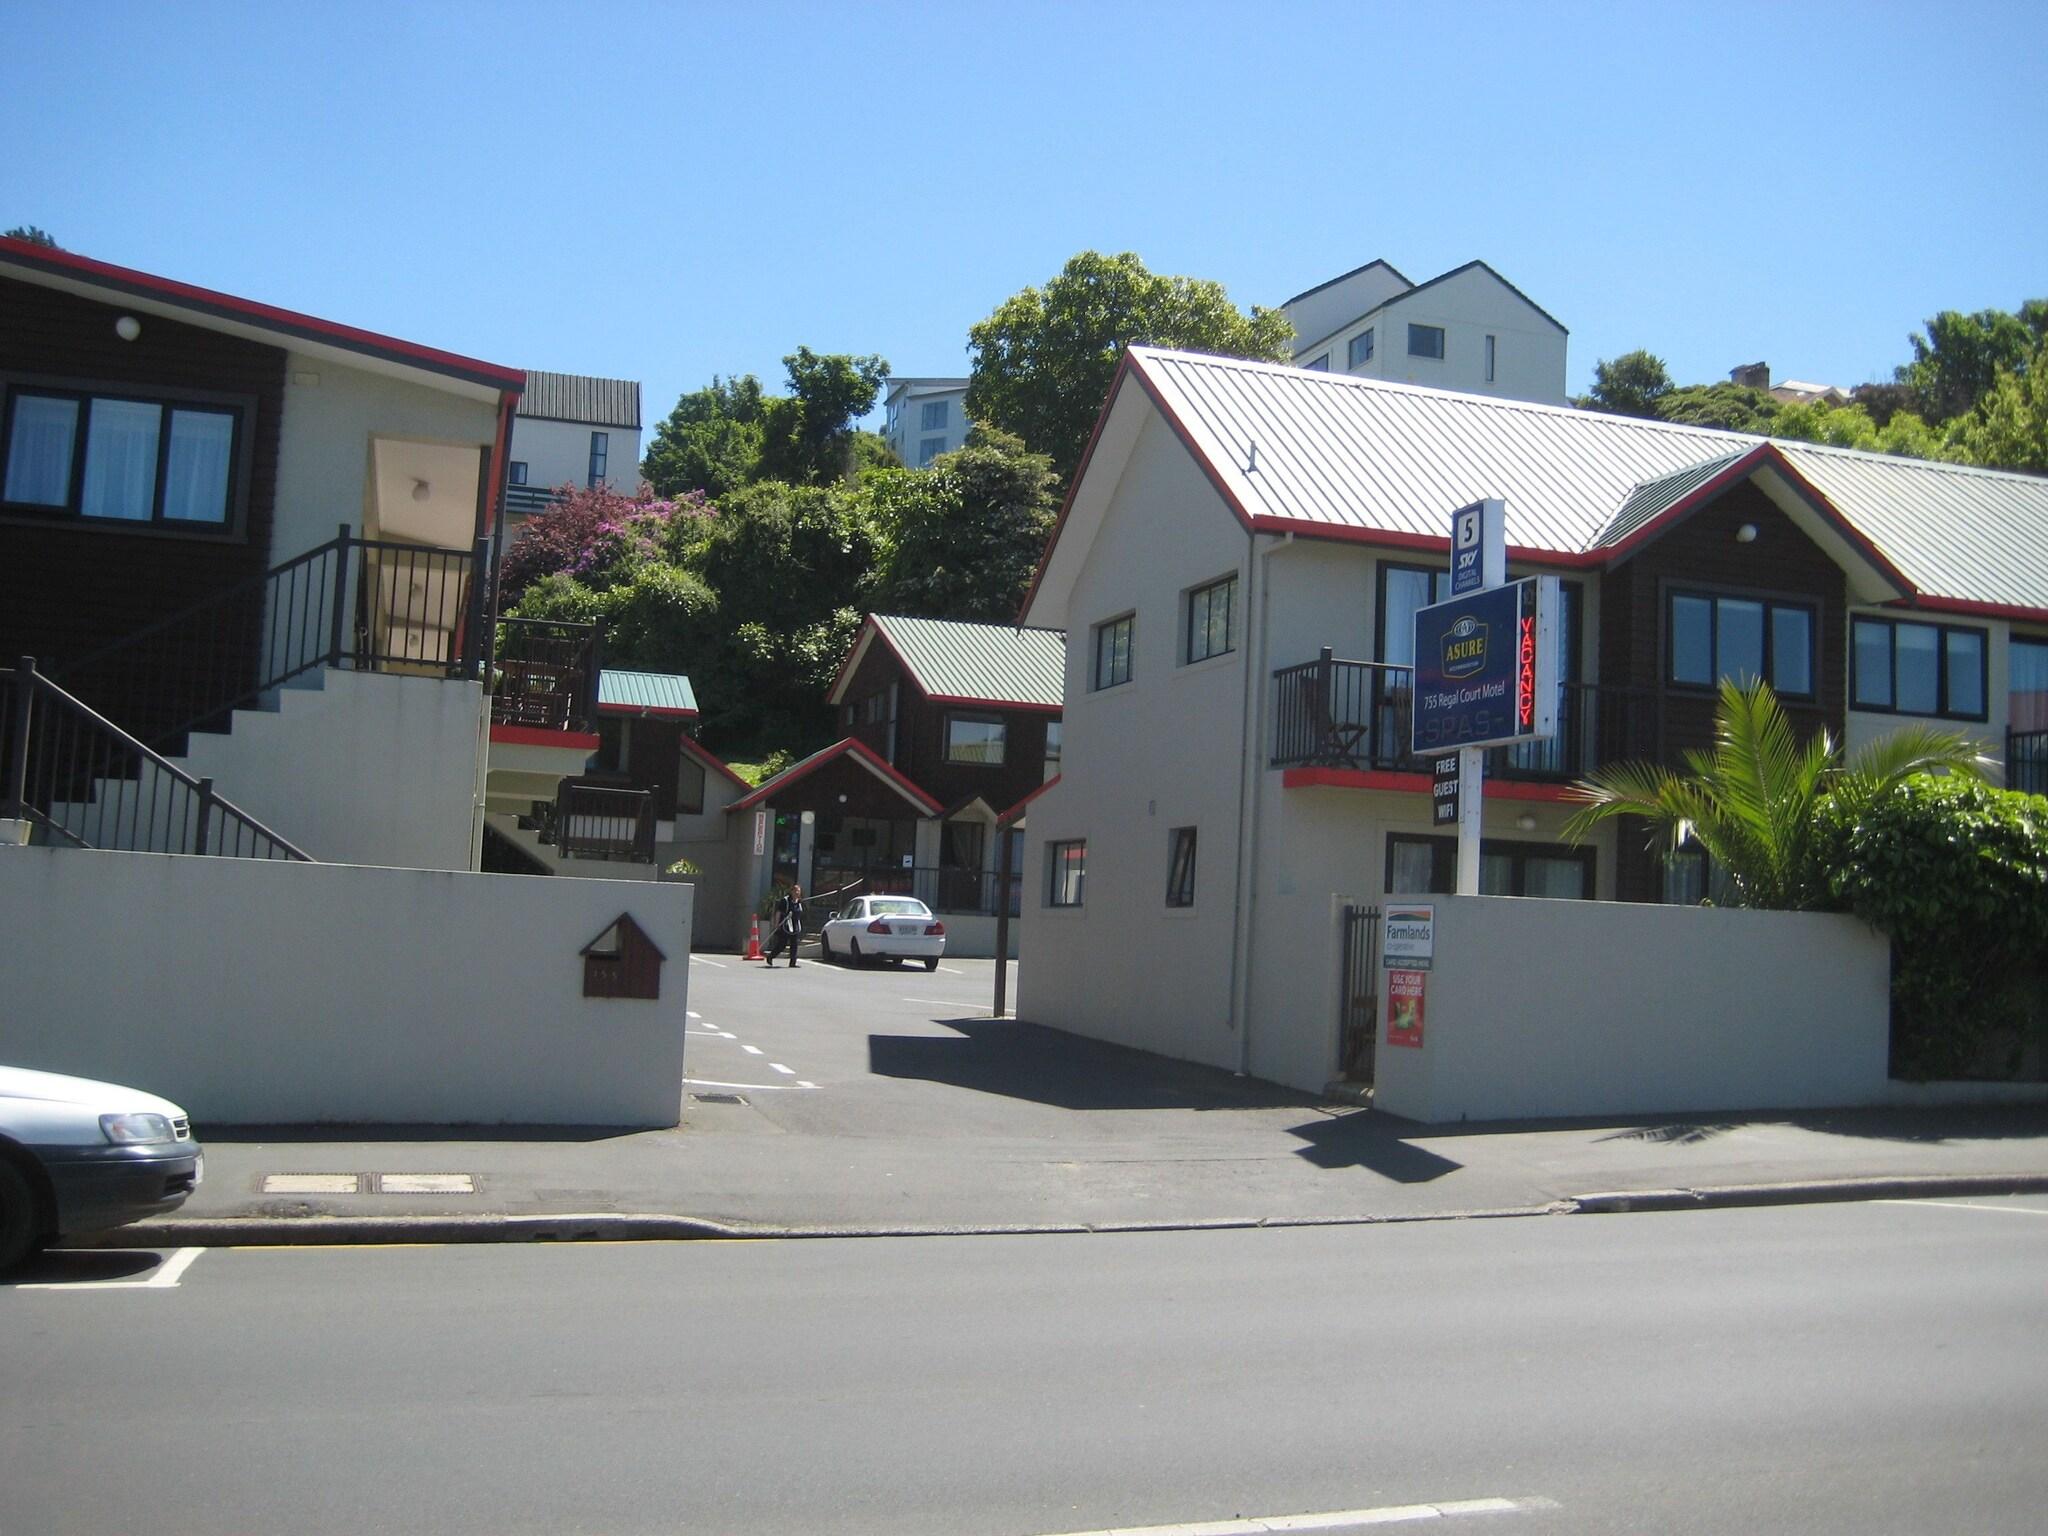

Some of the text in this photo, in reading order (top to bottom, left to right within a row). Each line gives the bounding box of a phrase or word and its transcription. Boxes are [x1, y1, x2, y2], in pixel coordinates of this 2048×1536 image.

[1464, 517, 1473, 543] 5
[1458, 549, 1478, 569] SKY
[1446, 638, 1484, 662] ASURE
[1519, 616, 1534, 726] VACANCY
[1424, 680, 1505, 710] 755 Regal Court Motel
[1435, 757, 1456, 775] FREE
[1433, 780, 1458, 798] GUEST
[1438, 803, 1453, 819] WIFI
[1387, 925, 1430, 940] Farmlands
[1392, 974, 1421, 985] USE YOUR
[1390, 984, 1423, 997] CARD HERE
